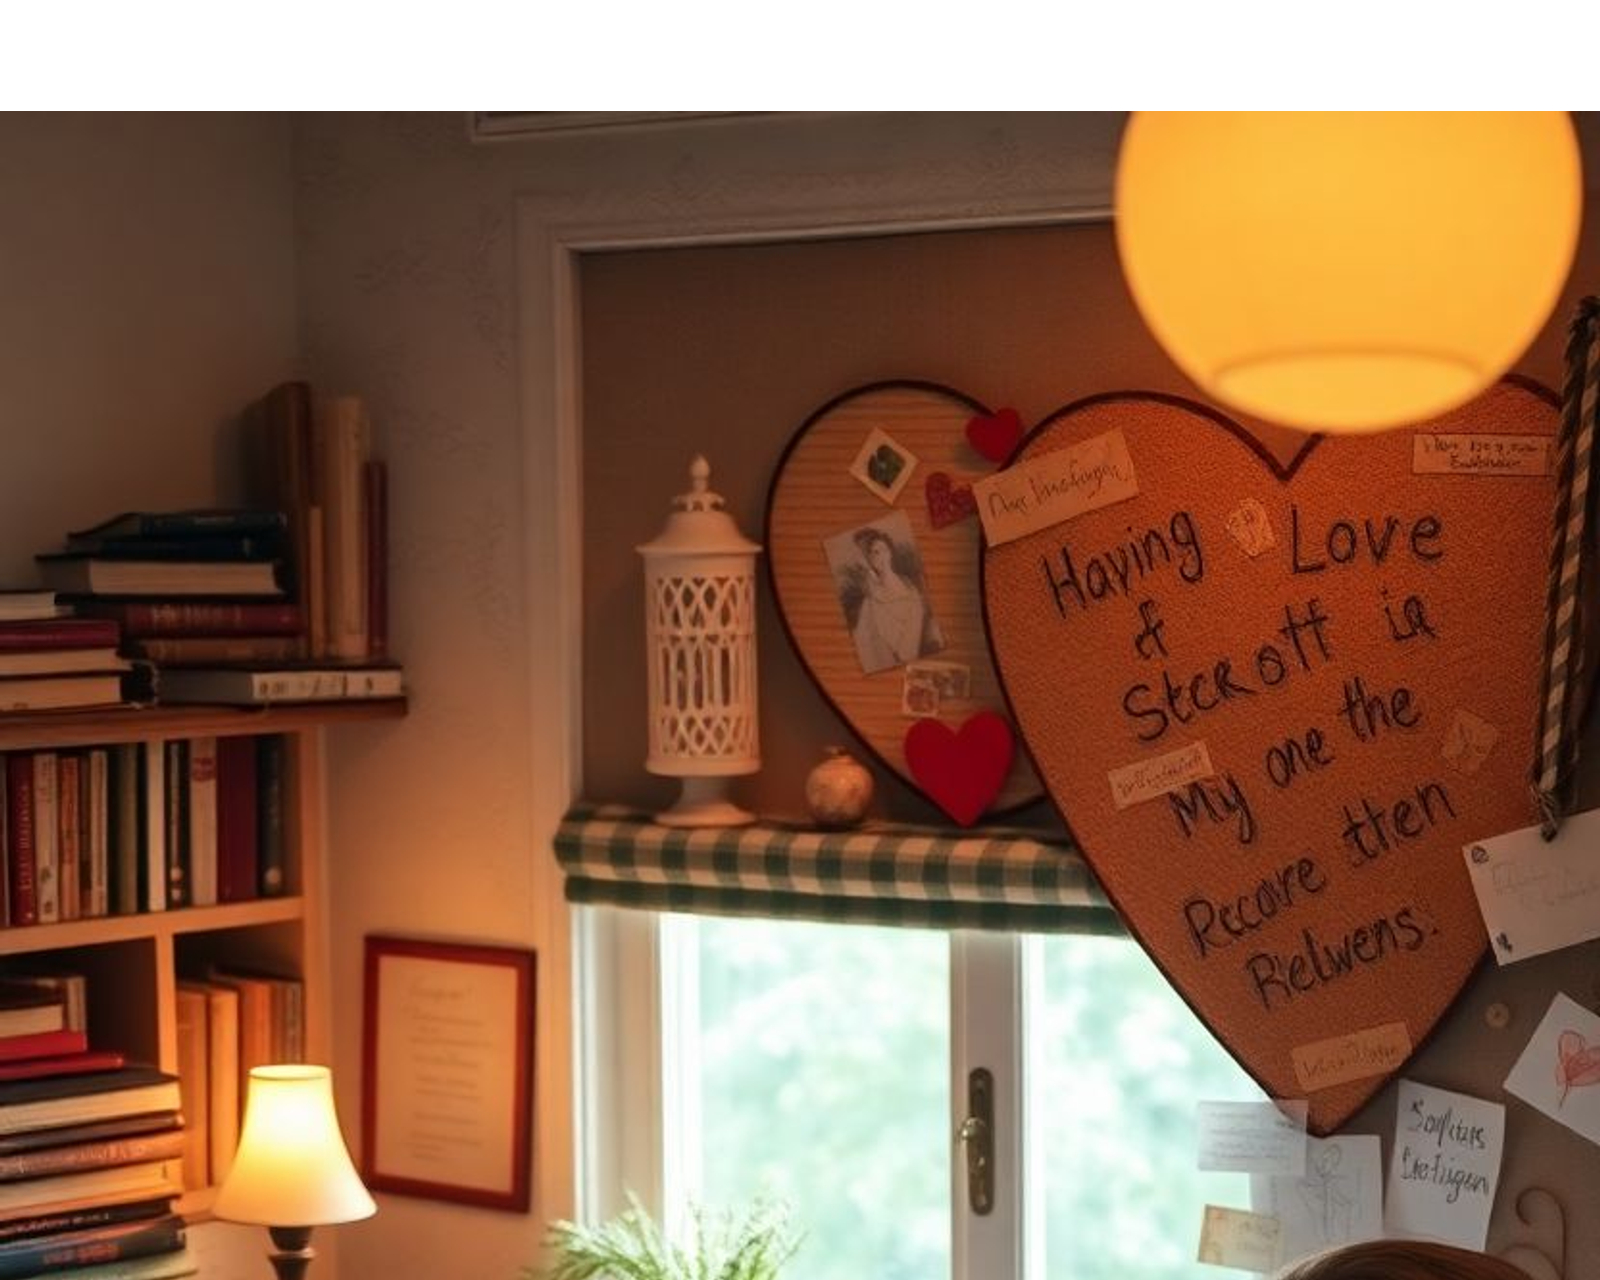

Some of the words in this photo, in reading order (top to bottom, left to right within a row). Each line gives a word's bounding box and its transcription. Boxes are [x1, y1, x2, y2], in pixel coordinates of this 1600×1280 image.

[1038, 510, 1204, 620] Having
[1290, 502, 1444, 576] Love
[1336, 676, 1422, 743] the
